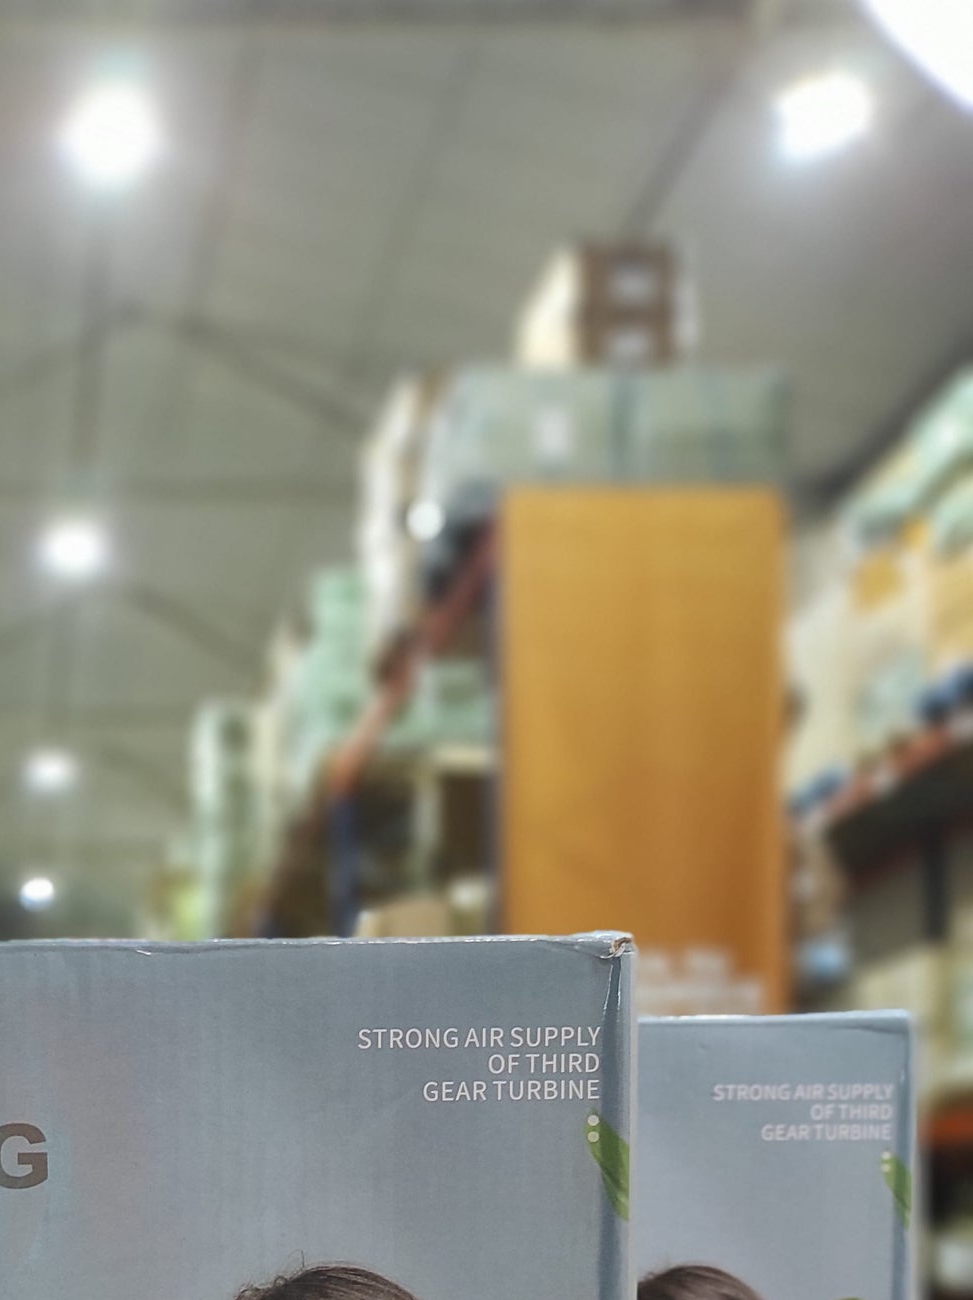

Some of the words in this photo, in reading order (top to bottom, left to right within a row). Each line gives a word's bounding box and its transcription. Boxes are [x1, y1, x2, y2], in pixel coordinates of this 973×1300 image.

[358, 1027, 459, 1049] STRONG
[464, 1027, 504, 1048] AIR
[510, 1026, 601, 1048] SUPPLY
[488, 1053, 520, 1074] OF
[525, 1053, 600, 1074] THIRD
[423, 1081, 487, 1102] GEAR
[493, 1079, 600, 1100] TURBINE
[712, 1083, 790, 1101] STRONG
[794, 1083, 825, 1100] AIR
[828, 1082, 894, 1100] SUPPLY
[810, 1103, 835, 1121] OF
[839, 1103, 894, 1120] THIRD
[761, 1124, 811, 1141] GEAR
[815, 1123, 893, 1141] TURBINE
